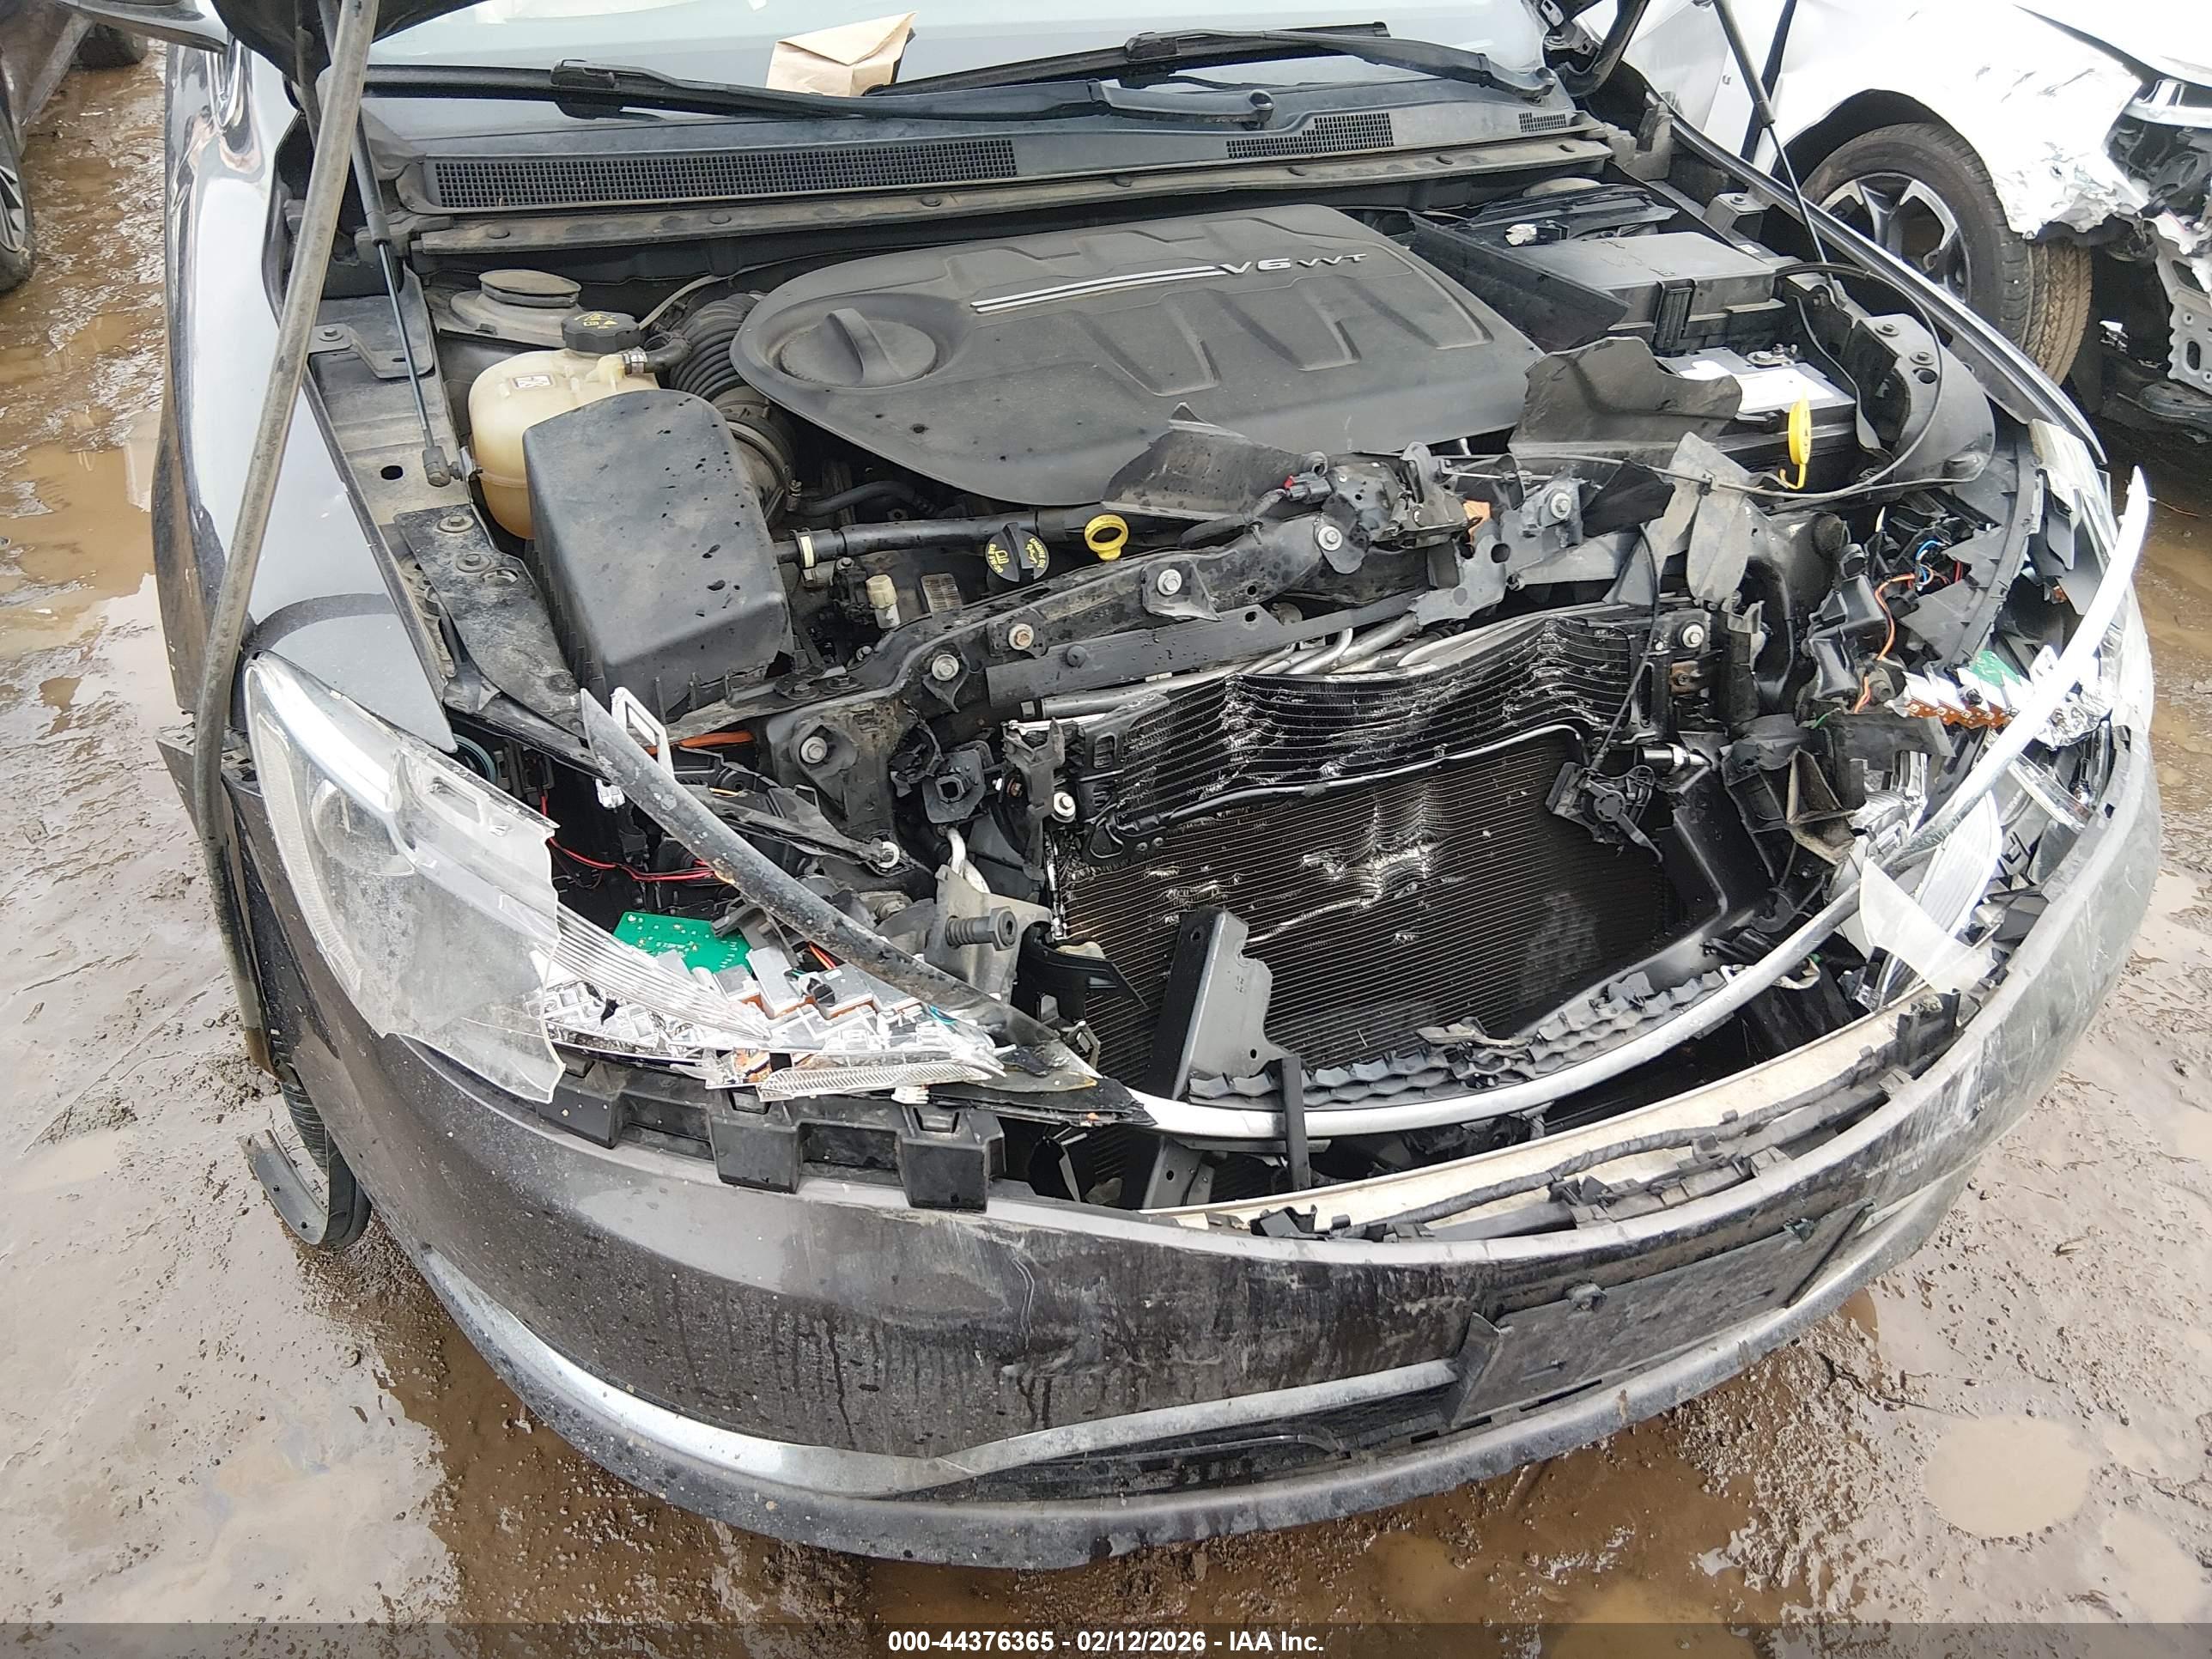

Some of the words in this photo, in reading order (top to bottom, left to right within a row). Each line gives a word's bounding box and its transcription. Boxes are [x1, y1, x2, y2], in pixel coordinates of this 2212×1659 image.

[1219, 258, 1291, 274] V6
[1297, 253, 1367, 268] VVT
[988, 543, 997, 555] SAE
[1029, 538, 1046, 558] ENGINE
[1036, 560, 1046, 568] OIL
